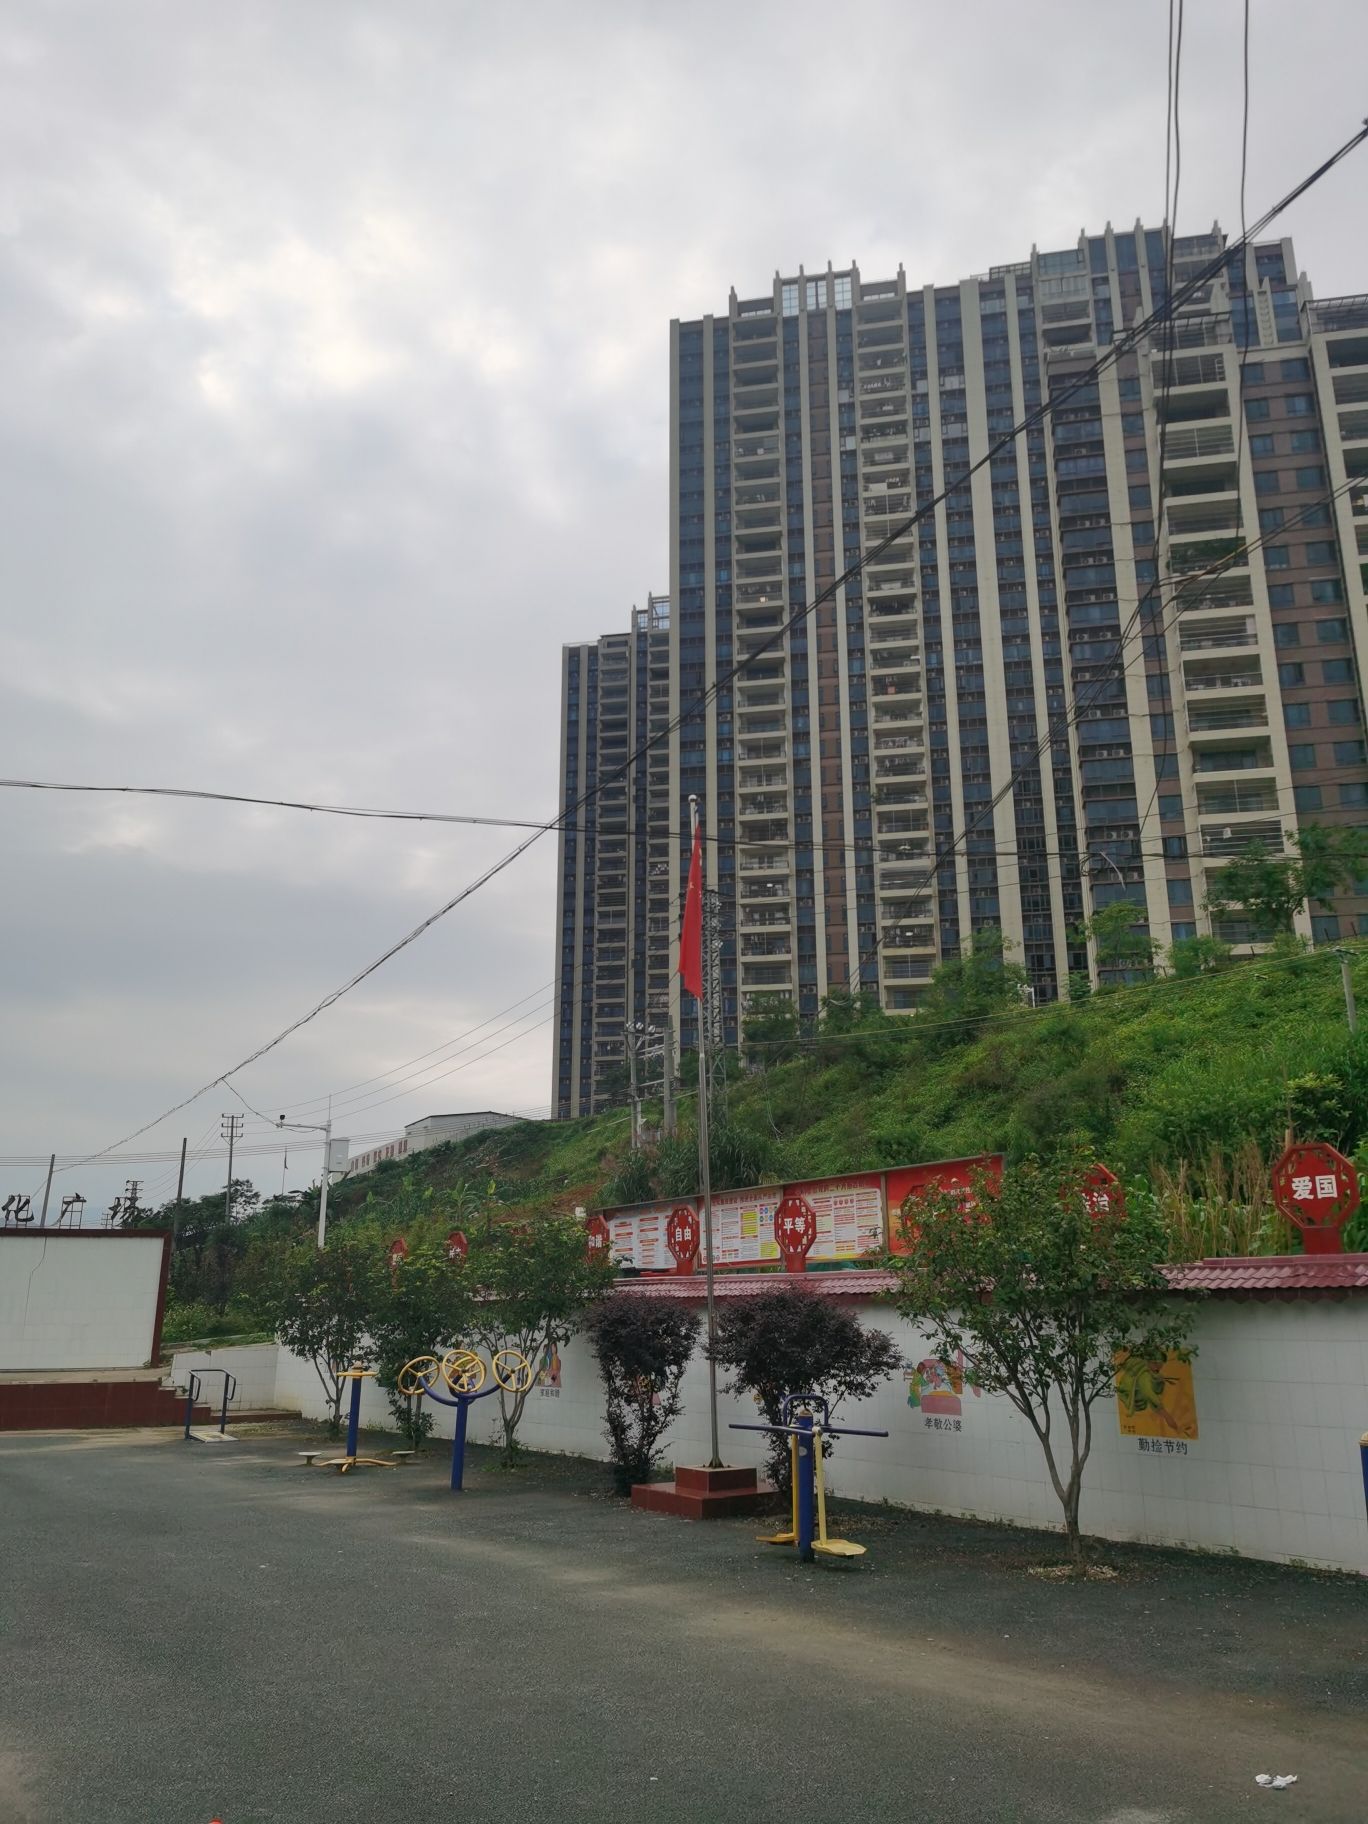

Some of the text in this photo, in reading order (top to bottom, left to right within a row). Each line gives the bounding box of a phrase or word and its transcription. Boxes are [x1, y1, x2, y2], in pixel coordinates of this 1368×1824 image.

[1291, 1174, 1338, 1200] 爱国
[675, 1226, 692, 1242] 自由
[783, 1217, 806, 1235] 平等
[924, 1417, 963, 1433] 孝敬公婆
